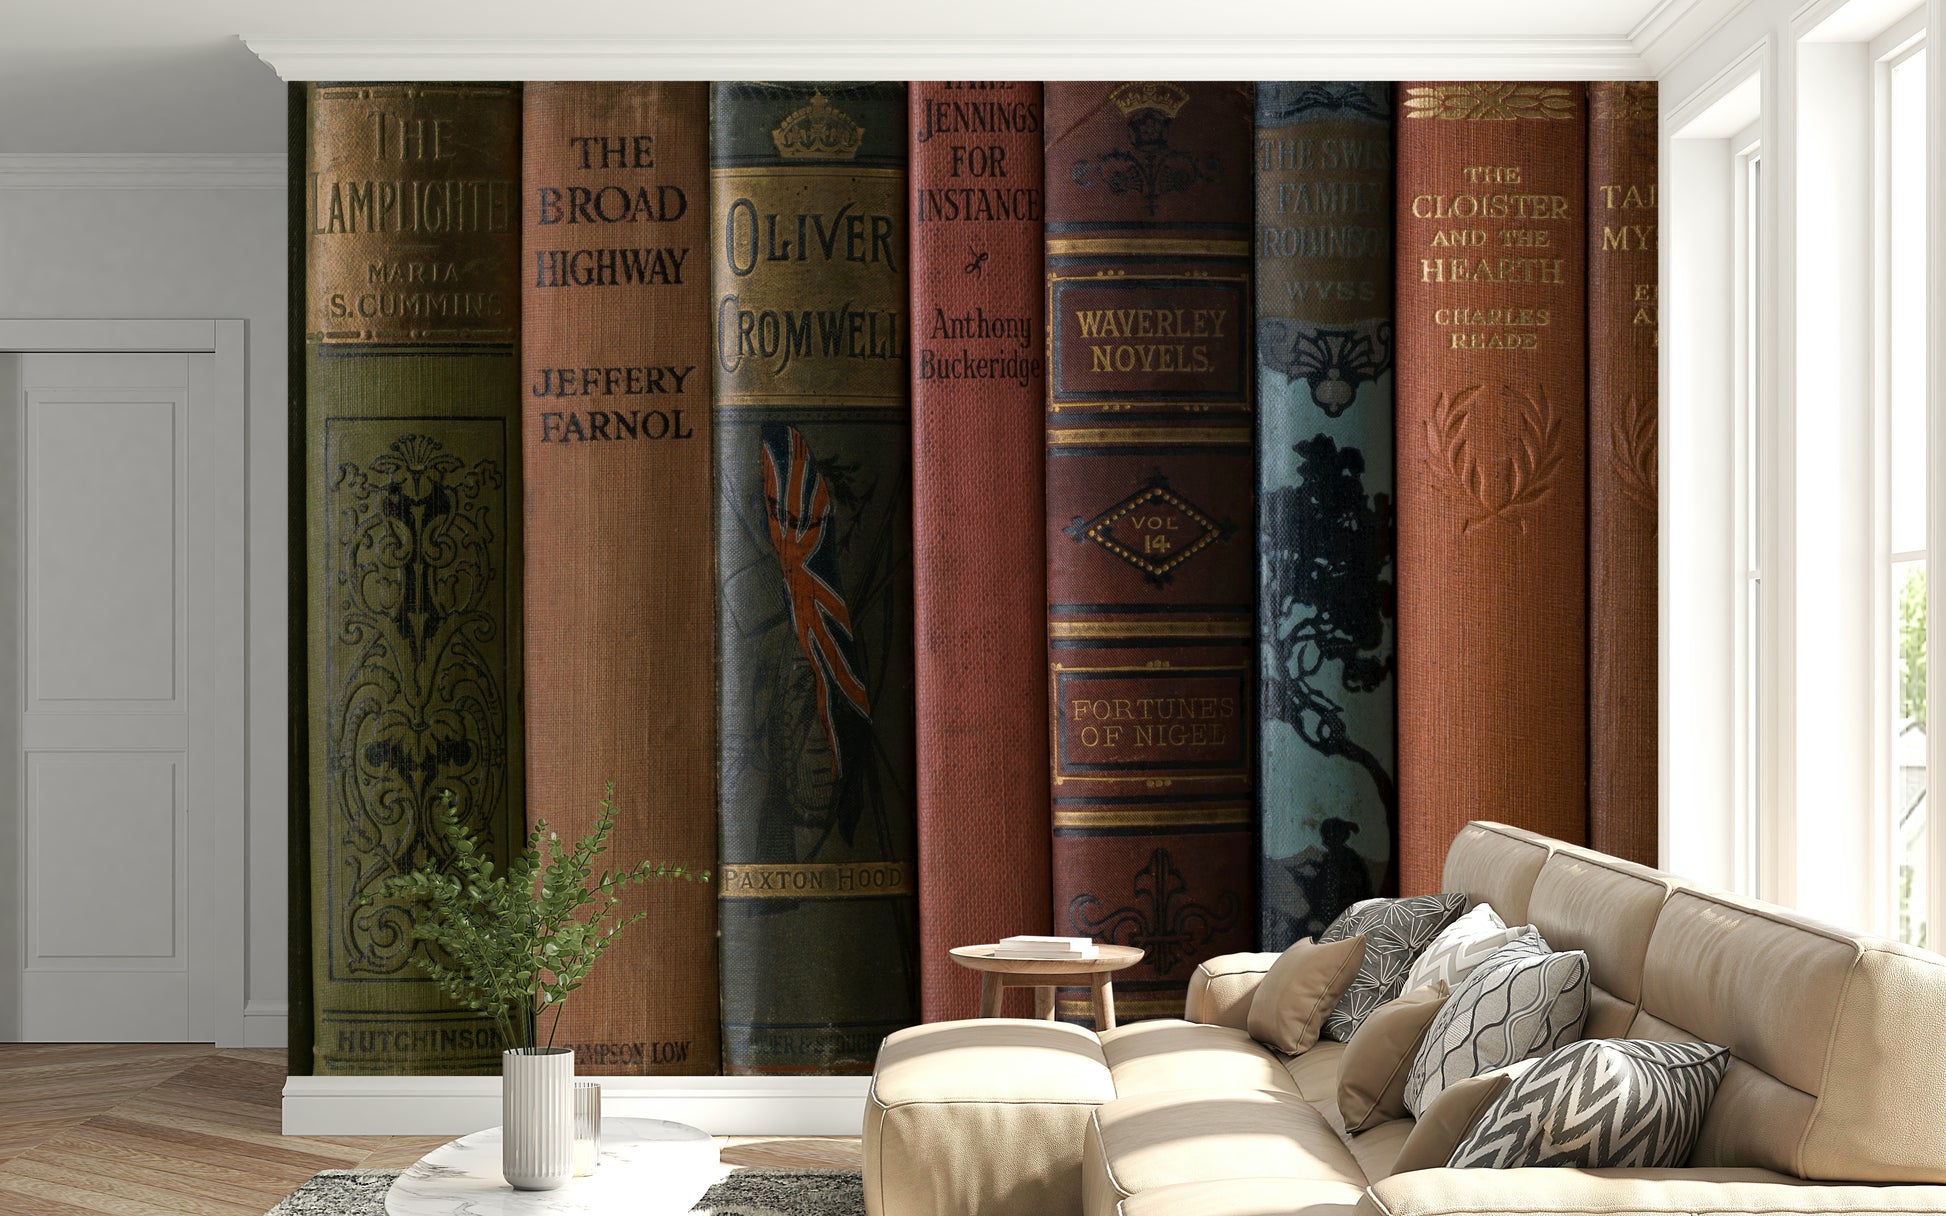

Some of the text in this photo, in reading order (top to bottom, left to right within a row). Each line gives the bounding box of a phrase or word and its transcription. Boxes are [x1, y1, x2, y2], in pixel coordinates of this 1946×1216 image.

[368, 110, 457, 160] THE
[917, 99, 1039, 143] JENNINGS
[571, 136, 655, 171] THE
[949, 146, 1007, 178] FOR
[1261, 138, 1315, 171] THE
[1464, 166, 1521, 184] THE
[537, 185, 688, 225] BROAD
[917, 188, 1040, 222] INSTANCE
[1411, 194, 1571, 220] CLOISTER
[725, 197, 898, 277] OLIVER
[1430, 229, 1551, 248] AND THE
[367, 262, 461, 284] MARIA
[535, 247, 690, 288] HIGHWAY
[1419, 257, 1565, 285] HEARTH
[1284, 279, 1376, 302] WYSS
[929, 307, 1033, 348] Anthony
[1075, 308, 1227, 338] WAVERLEY
[1434, 308, 1550, 326] CHARLES
[718, 293, 903, 378] CROMWELL
[1450, 332, 1538, 350] READE
[919, 348, 1041, 388] Buckeridge
[1091, 344, 1216, 374] NOVELS.
[532, 365, 697, 398] JEFFERY
[540, 409, 693, 444] FARNOL
[1131, 516, 1179, 530] VOL
[1144, 534, 1171, 554] 14
[1071, 697, 1234, 721] FORTUNES
[1080, 723, 1226, 748] OF NIGEL
[724, 867, 902, 891] PAXTON HOOD
[337, 1027, 504, 1053] HUTCHINSON
[651, 1041, 692, 1064] LOW
